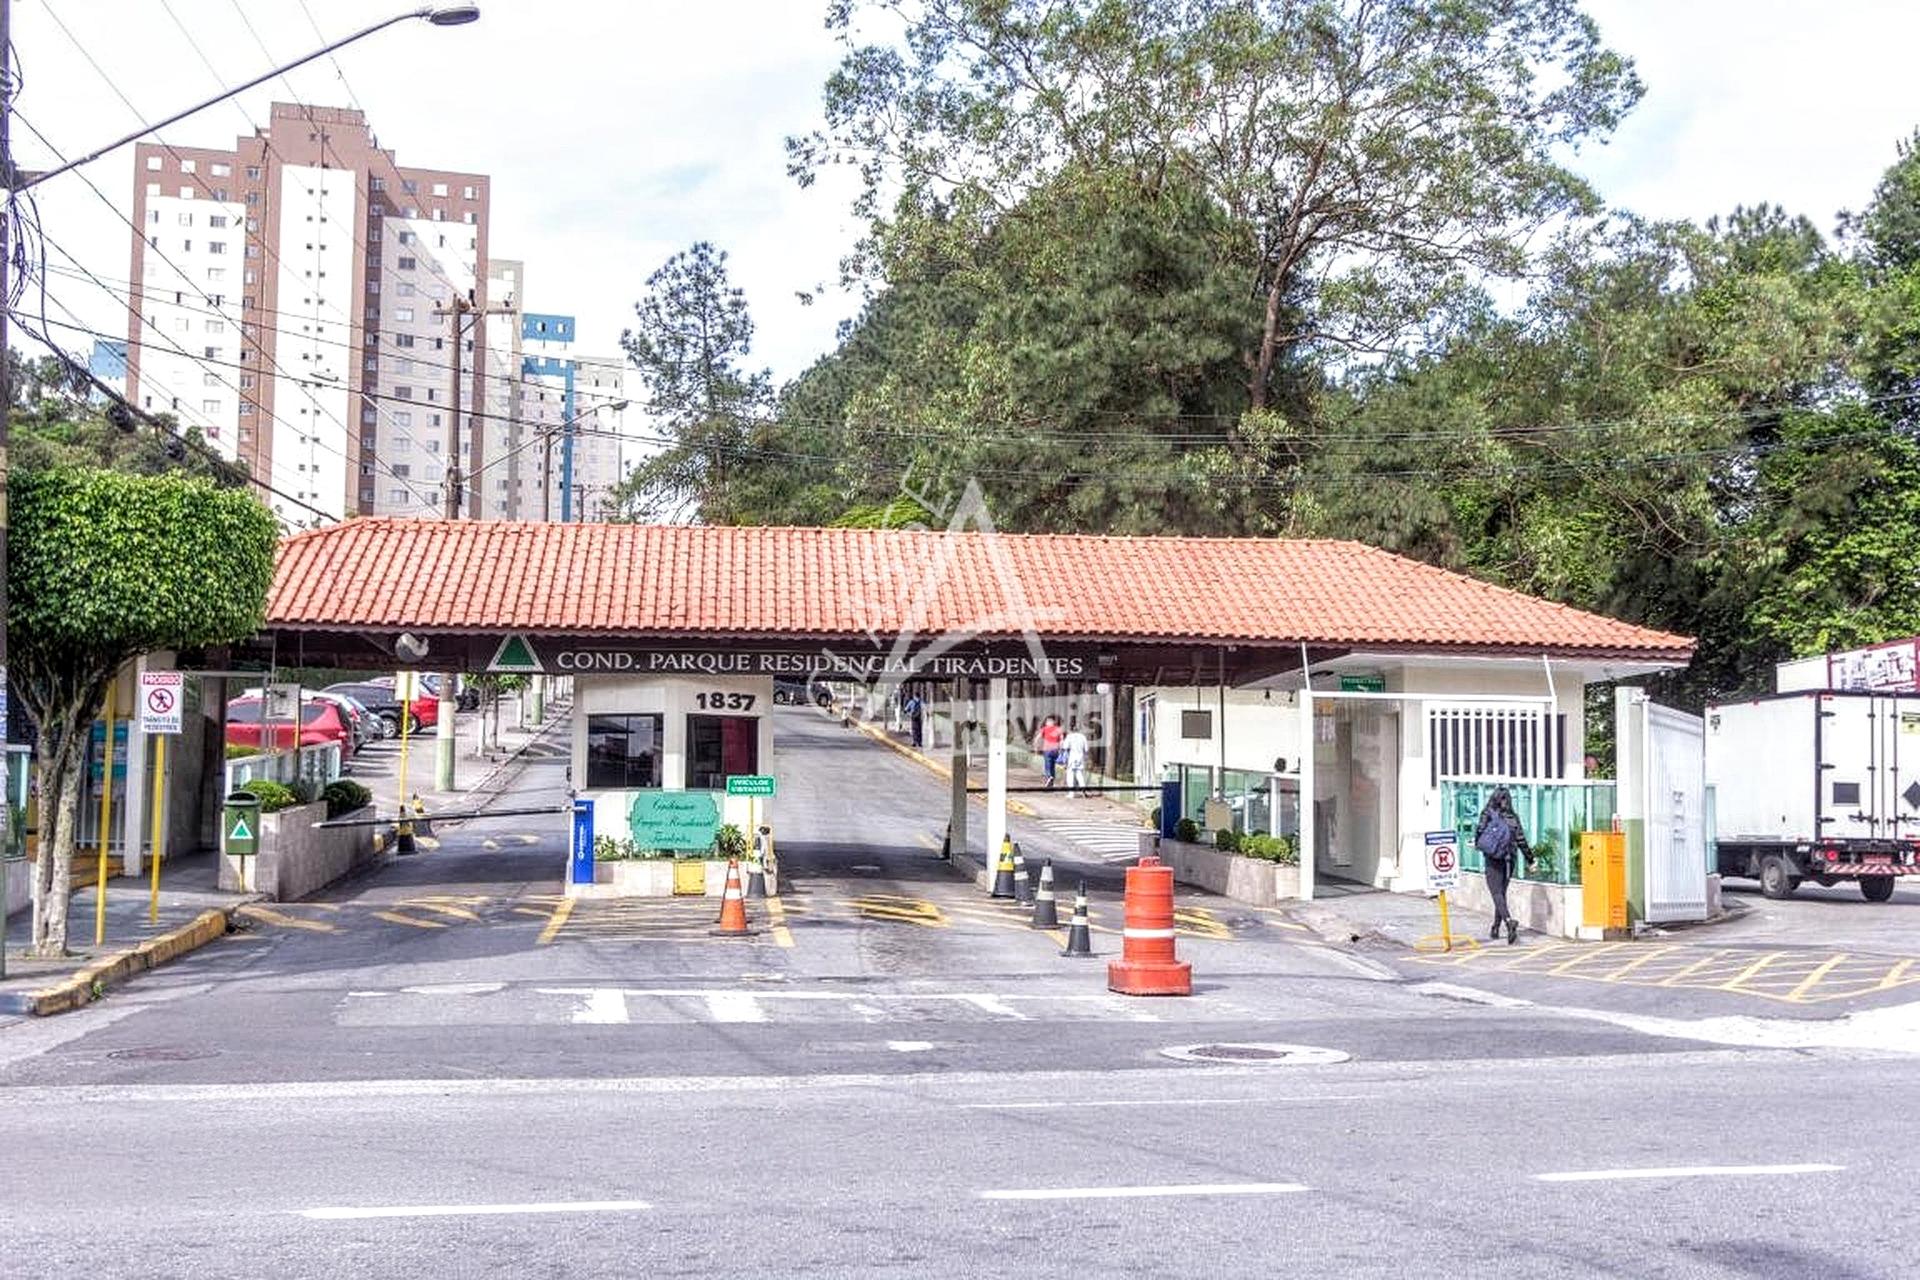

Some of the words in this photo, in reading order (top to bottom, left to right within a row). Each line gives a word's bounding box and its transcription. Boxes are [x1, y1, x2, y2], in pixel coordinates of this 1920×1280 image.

[557, 652, 640, 670] COND.
[650, 653, 750, 674] PARQUE
[760, 654, 921, 674] RESIDENCIAL
[929, 656, 1084, 675] TIRADENTES
[696, 692, 756, 712] 1837
